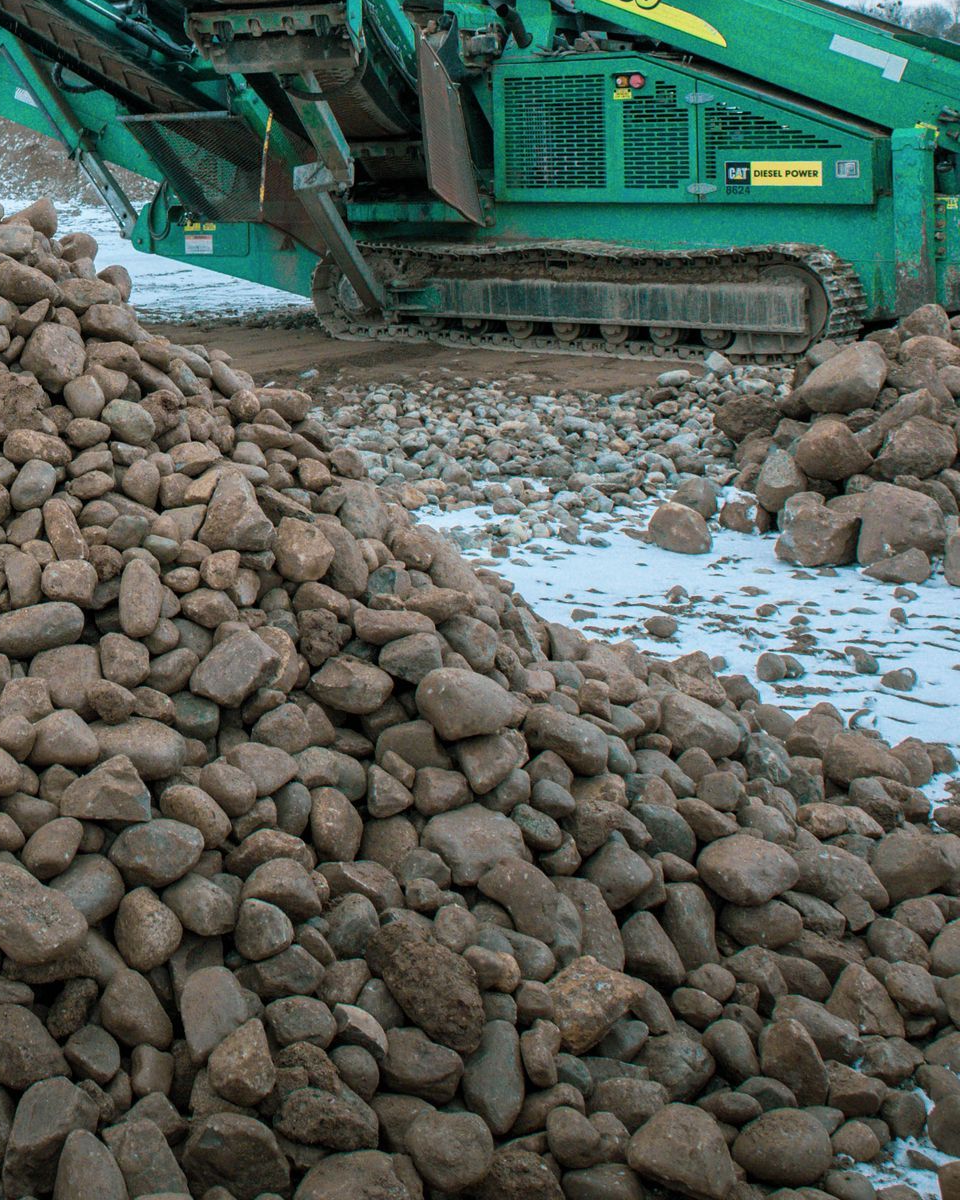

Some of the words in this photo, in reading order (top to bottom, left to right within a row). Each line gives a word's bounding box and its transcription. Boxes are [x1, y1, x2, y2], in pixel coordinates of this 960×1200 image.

[728, 167, 748, 180] CAT
[753, 170, 782, 178] DIESEL
[785, 169, 819, 178] POWER
